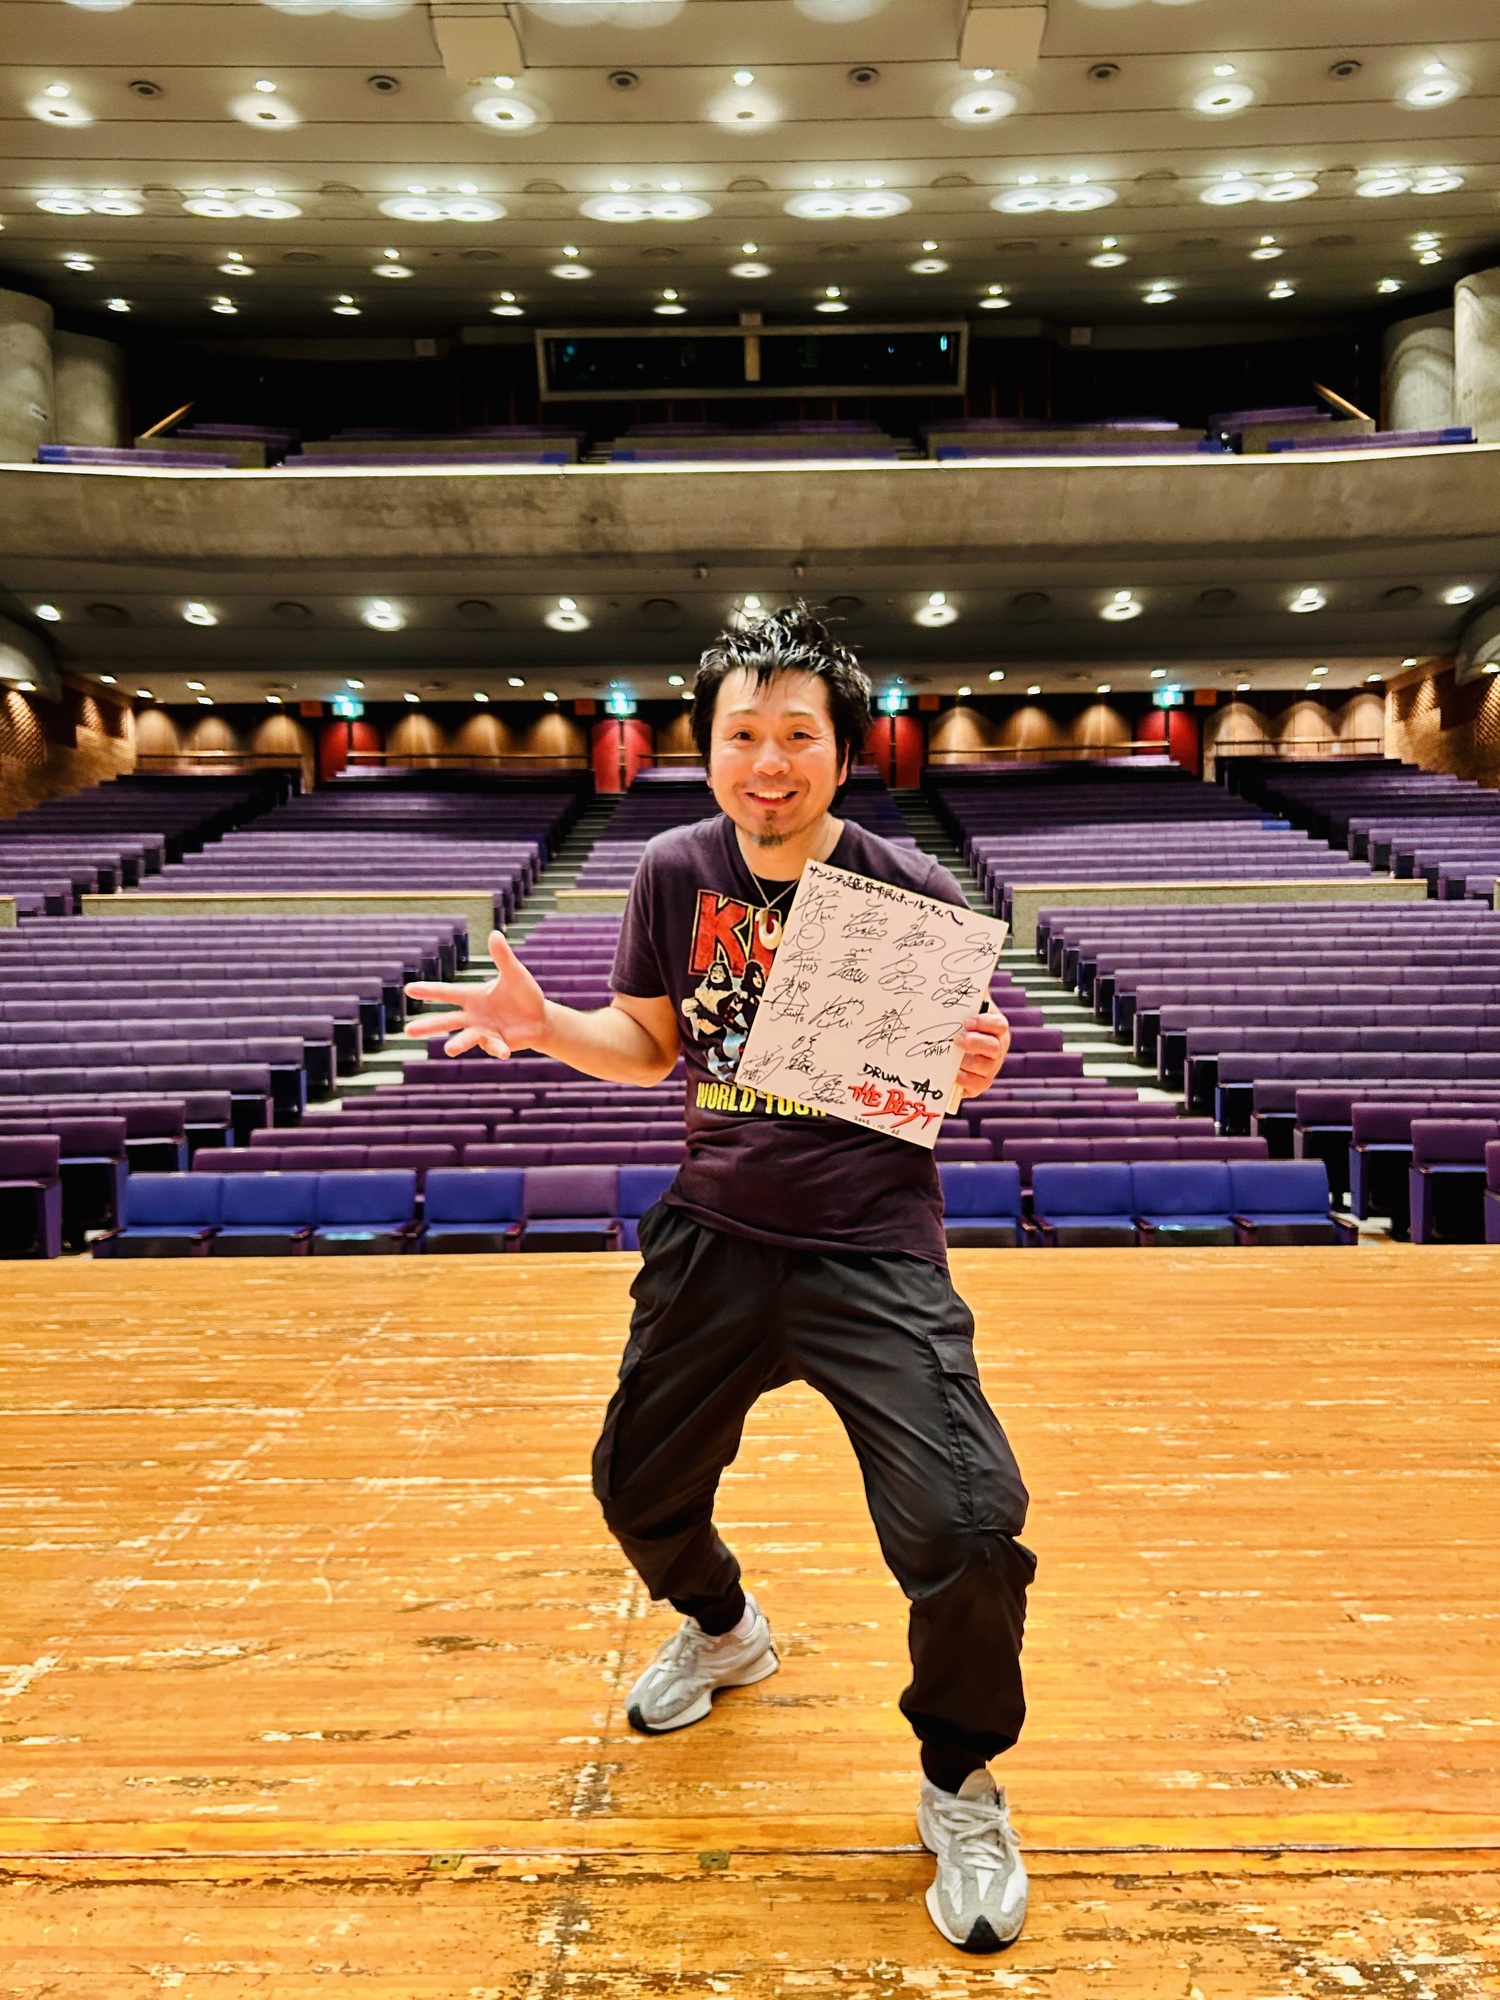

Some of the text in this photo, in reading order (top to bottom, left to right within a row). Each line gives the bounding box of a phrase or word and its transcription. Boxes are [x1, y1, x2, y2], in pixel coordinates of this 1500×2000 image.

[695, 1081, 757, 1113] WORLD
[847, 1080, 883, 1108] THE
[857, 1062, 910, 1089] DRUM
[910, 1078, 944, 1101] TAO
[860, 1088, 942, 1130] BEST
